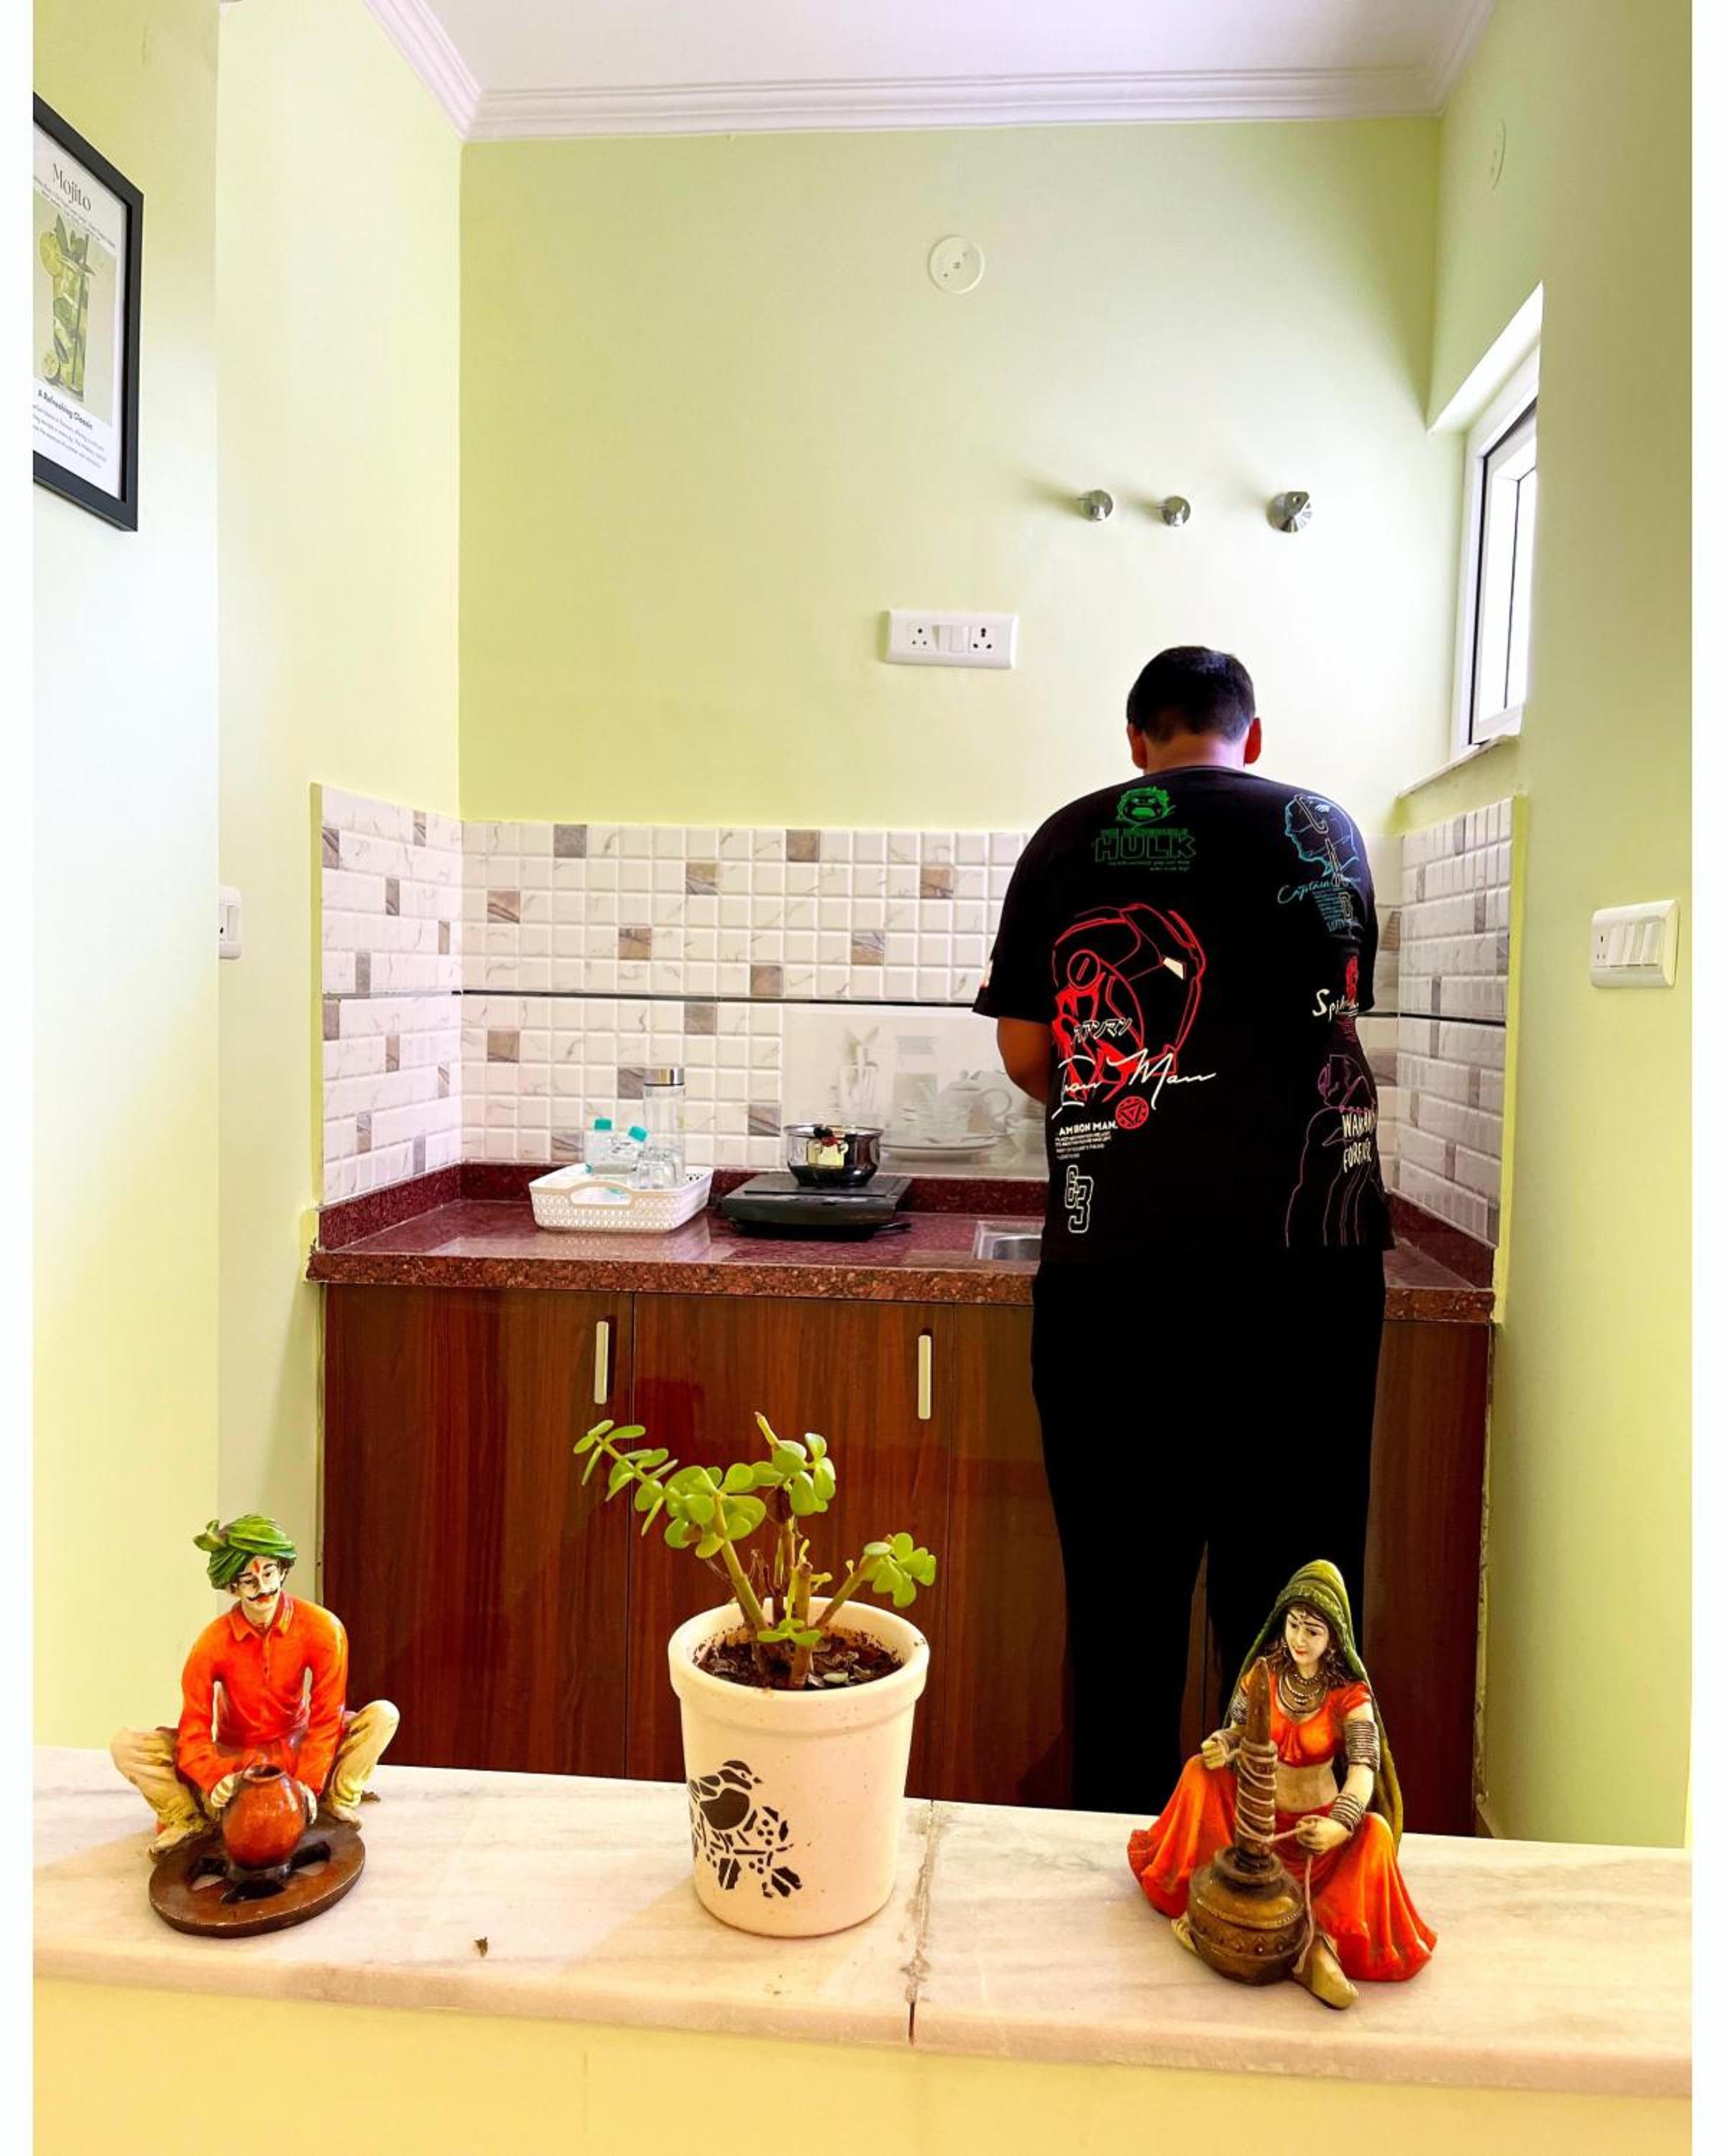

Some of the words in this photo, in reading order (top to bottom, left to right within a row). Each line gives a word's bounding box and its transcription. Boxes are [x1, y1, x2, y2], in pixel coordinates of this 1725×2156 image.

[52, 162, 92, 212] Mojito
[1095, 829, 1196, 862] HULK
[1277, 880, 1330, 904] Captain
[1105, 1047, 1217, 1110] Man
